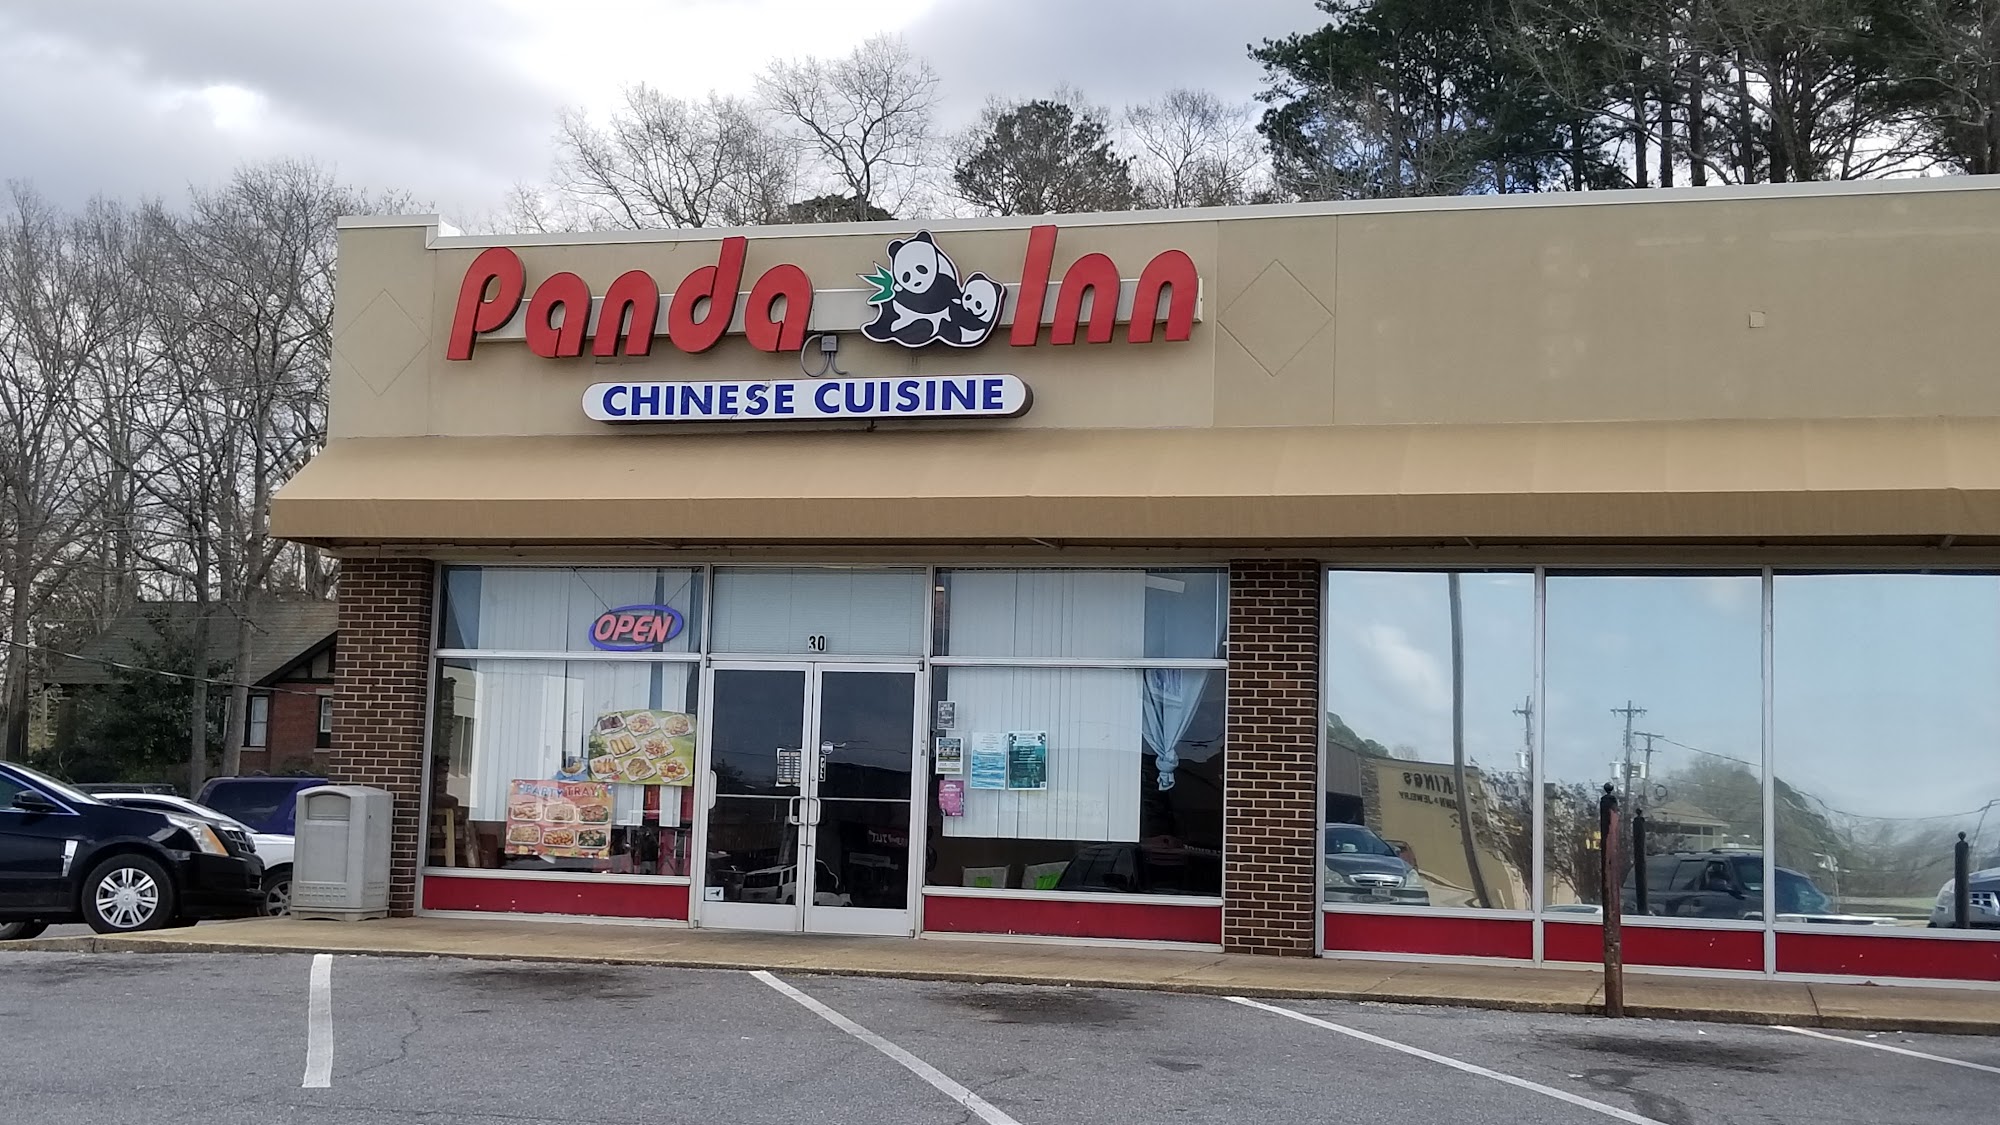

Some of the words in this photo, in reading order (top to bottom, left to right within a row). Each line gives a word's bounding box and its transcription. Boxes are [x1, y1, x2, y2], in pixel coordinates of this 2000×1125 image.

[447, 237, 812, 360] Panda
[1009, 225, 1198, 347] Inn
[602, 384, 795, 416] CHINESE
[814, 378, 1004, 413] CUISINE
[594, 614, 672, 643] OPEN
[808, 635, 826, 651] 30
[525, 785, 562, 798] PARTY
[566, 786, 597, 797] TRAY
